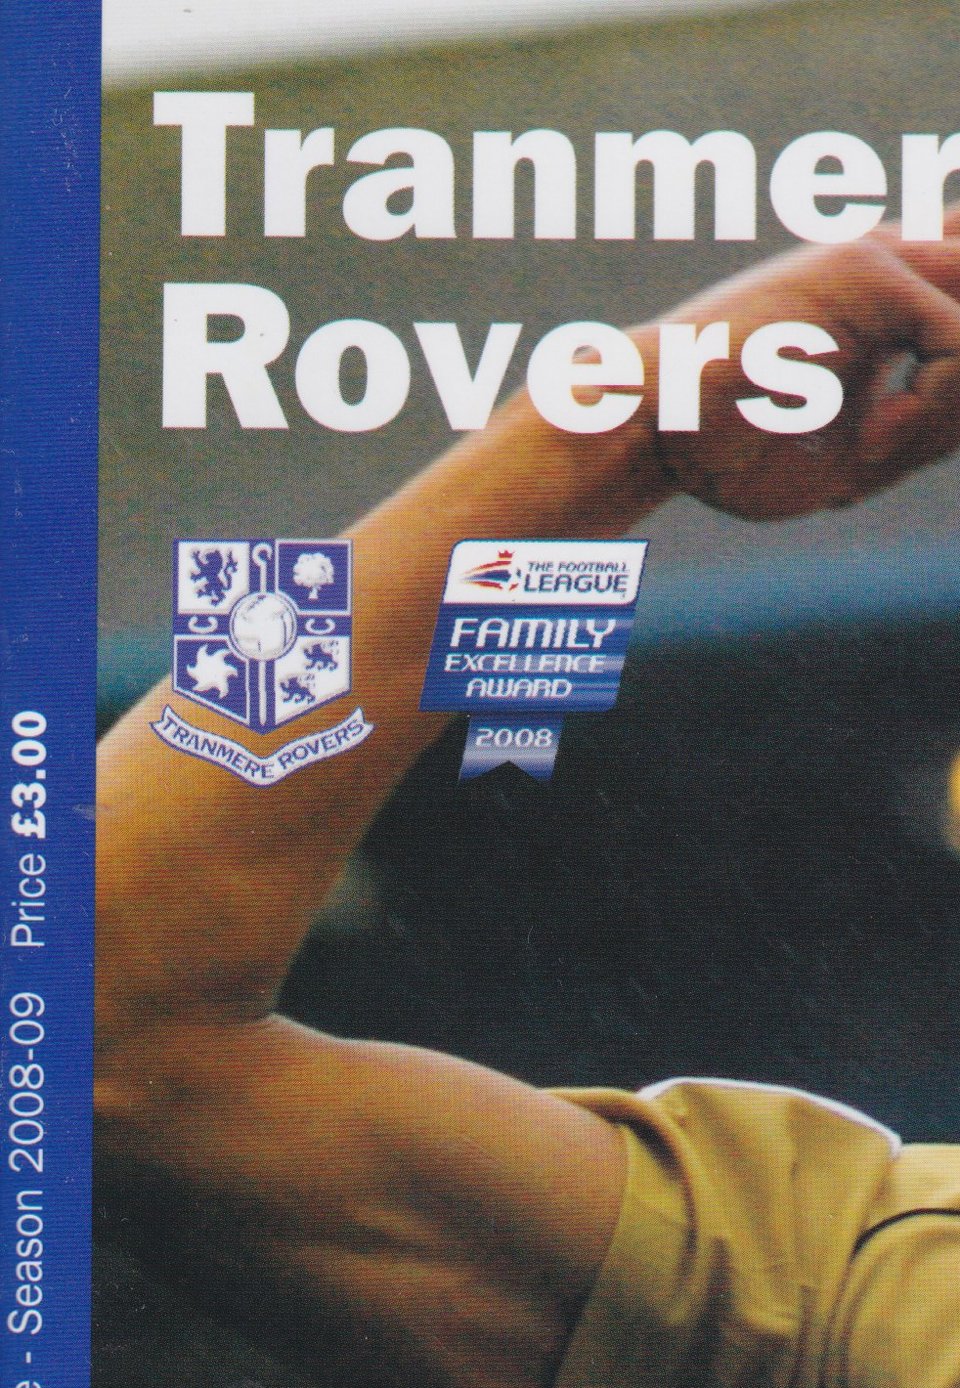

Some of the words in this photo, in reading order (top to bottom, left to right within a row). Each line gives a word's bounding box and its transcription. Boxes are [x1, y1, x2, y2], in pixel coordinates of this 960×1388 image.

[162, 281, 843, 434] Rovers
[523, 574, 628, 593] LEAGUE
[527, 560, 554, 573] THE
[557, 561, 629, 573] FOOTBALL
[450, 617, 617, 649] FAMILY
[444, 653, 607, 673] EXCELLENCE
[465, 678, 573, 698] AWARD
[161, 715, 275, 780] TRANMERE
[277, 719, 364, 770] ROVERS
[474, 728, 553, 748] 2008
[11, 710, 47, 839] £3.00
[11, 853, 46, 948] Price
[8, 992, 46, 1172] 2008-09
[7, 1190, 43, 1336] Season
